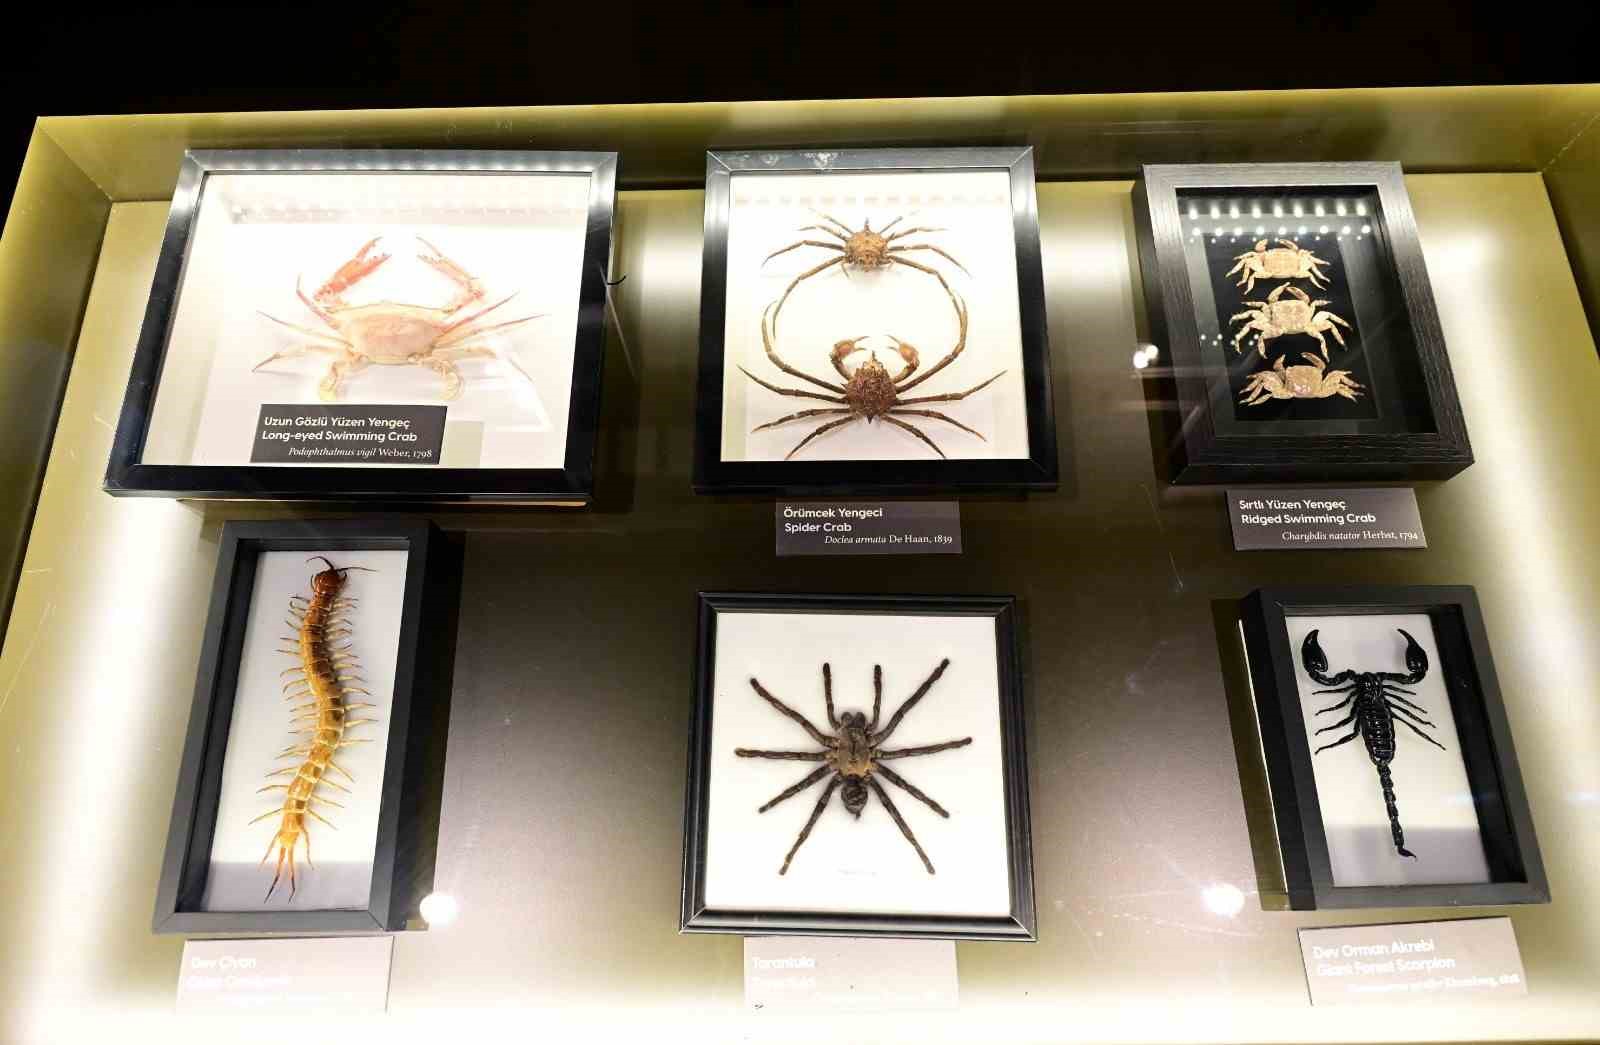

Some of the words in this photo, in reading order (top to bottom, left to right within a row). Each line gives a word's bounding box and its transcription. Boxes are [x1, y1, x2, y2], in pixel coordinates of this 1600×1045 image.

[264, 416, 293, 426] Uzun
[295, 416, 328, 427] Gözlü
[331, 416, 365, 427] Yüzen
[368, 417, 411, 430] Yengeç
[262, 430, 324, 442] Long-eyed
[325, 431, 386, 443] Swimming
[388, 431, 418, 442] Crab
[356, 448, 377, 459] vigil
[378, 448, 411, 459] Weber,
[413, 449, 433, 460] 1798
[1239, 499, 1265, 510] Sırtlı
[1266, 499, 1302, 510] Yüzen
[1304, 499, 1347, 511] Yengeç
[783, 506, 836, 518] Örümcek
[838, 507, 883, 520] Yengeci
[1241, 513, 1283, 526] Ridged
[1283, 513, 1345, 526] Swimming
[1346, 513, 1377, 523] Crab
[784, 522, 821, 534] Spider
[823, 522, 852, 533] Crab
[855, 536, 887, 544] armata
[889, 535, 903, 544] De
[904, 535, 932, 545] Haan,
[934, 535, 953, 545] 1839
[1399, 531, 1418, 542] 1794
